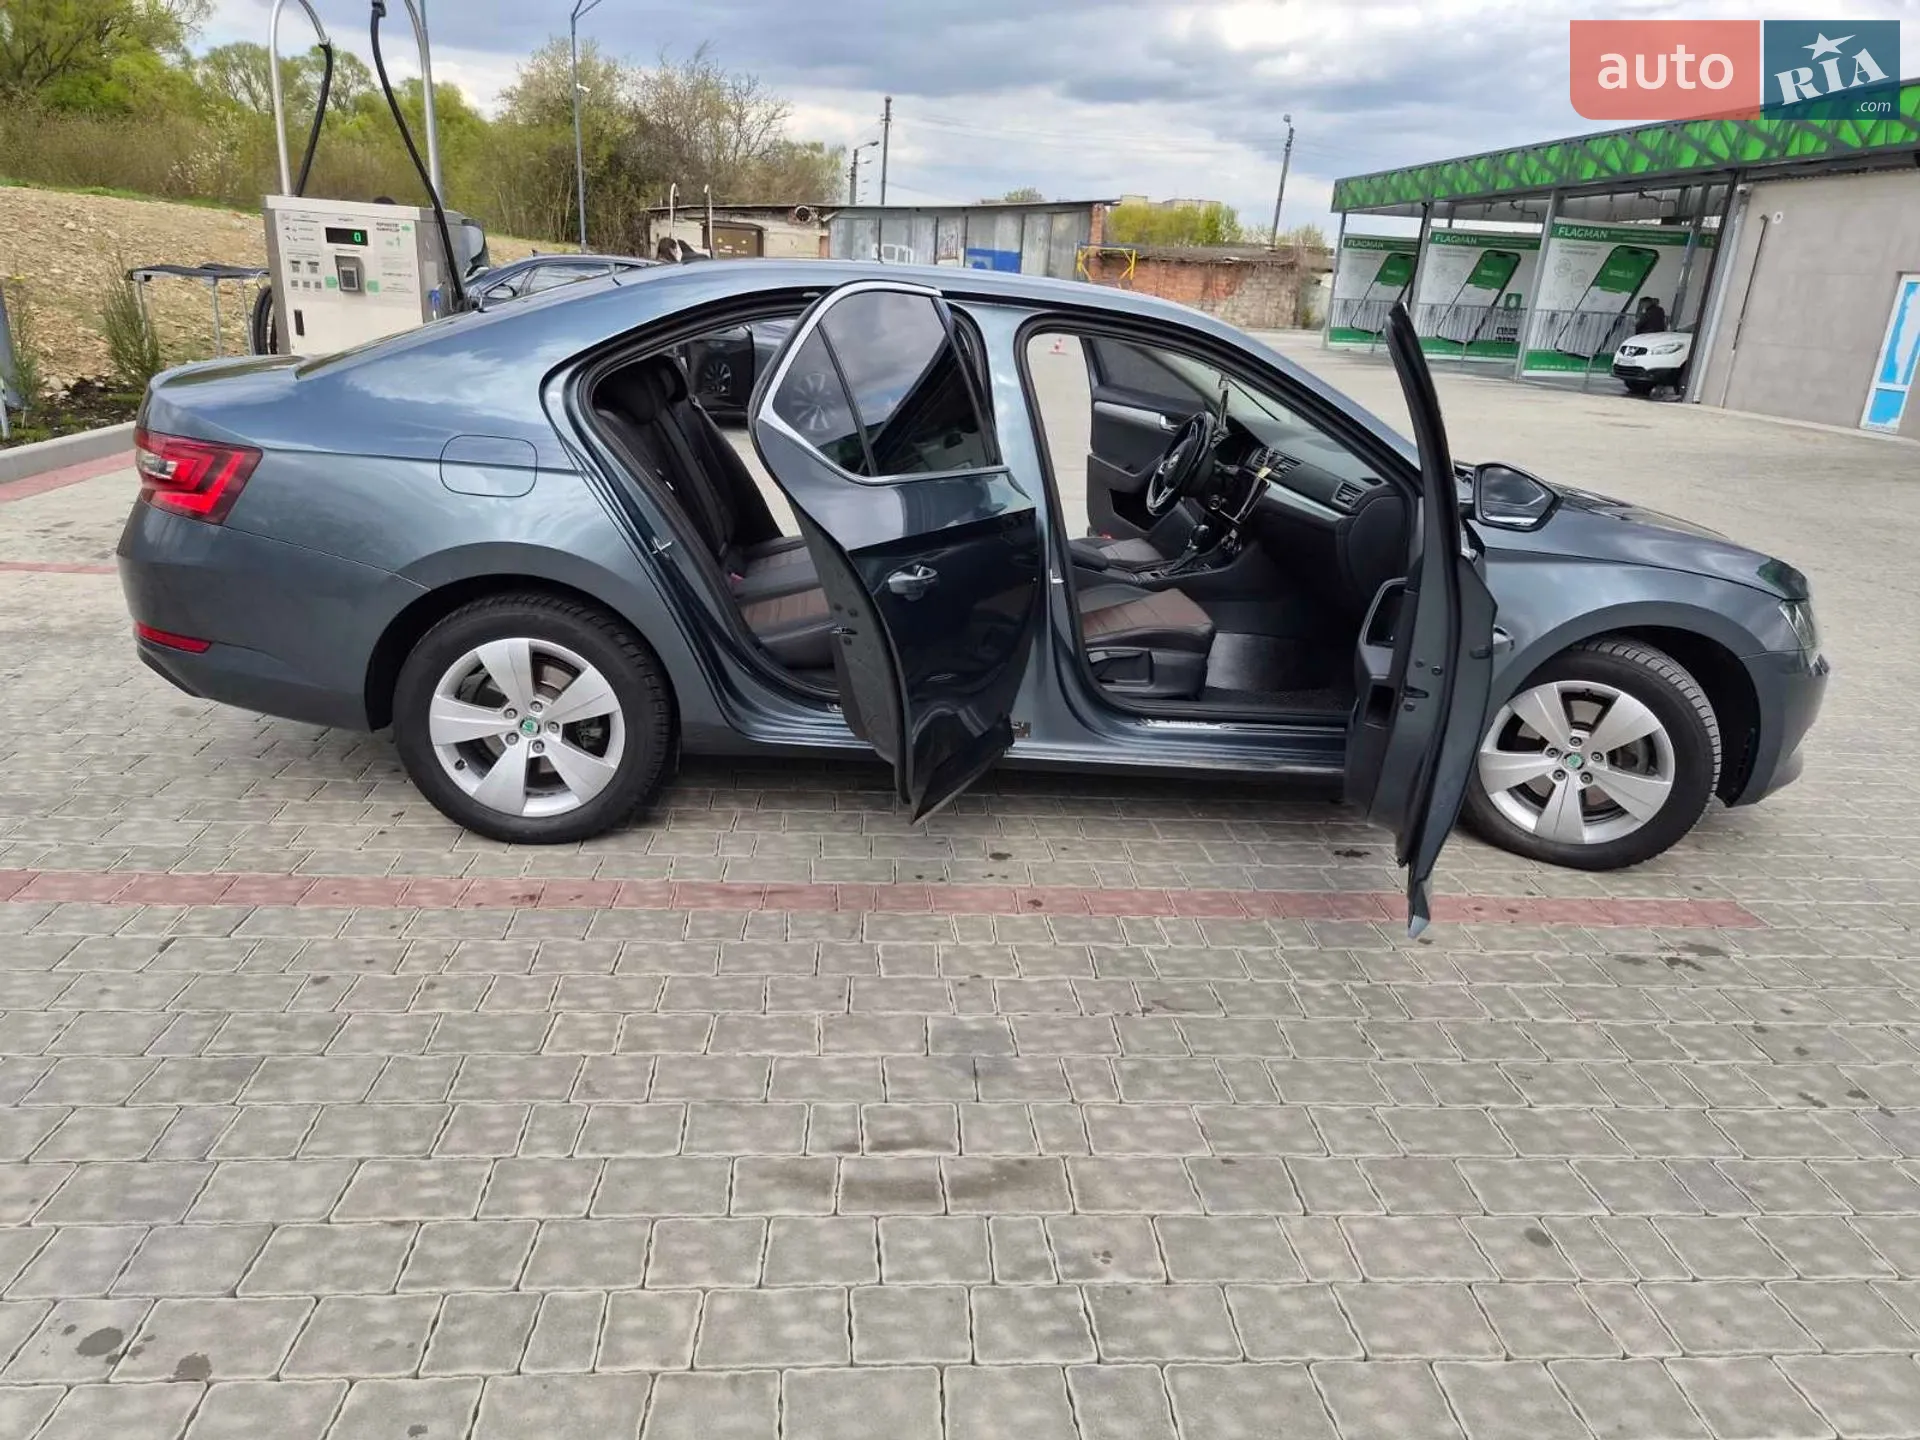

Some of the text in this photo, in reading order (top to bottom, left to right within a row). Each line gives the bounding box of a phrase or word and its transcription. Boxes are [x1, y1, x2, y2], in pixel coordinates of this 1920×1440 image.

[353, 232, 362, 242] 0
[1557, 226, 1609, 240] FLAGMAN
[1347, 239, 1384, 250] FLAGMAN
[1434, 233, 1478, 245] FLAGMAN
